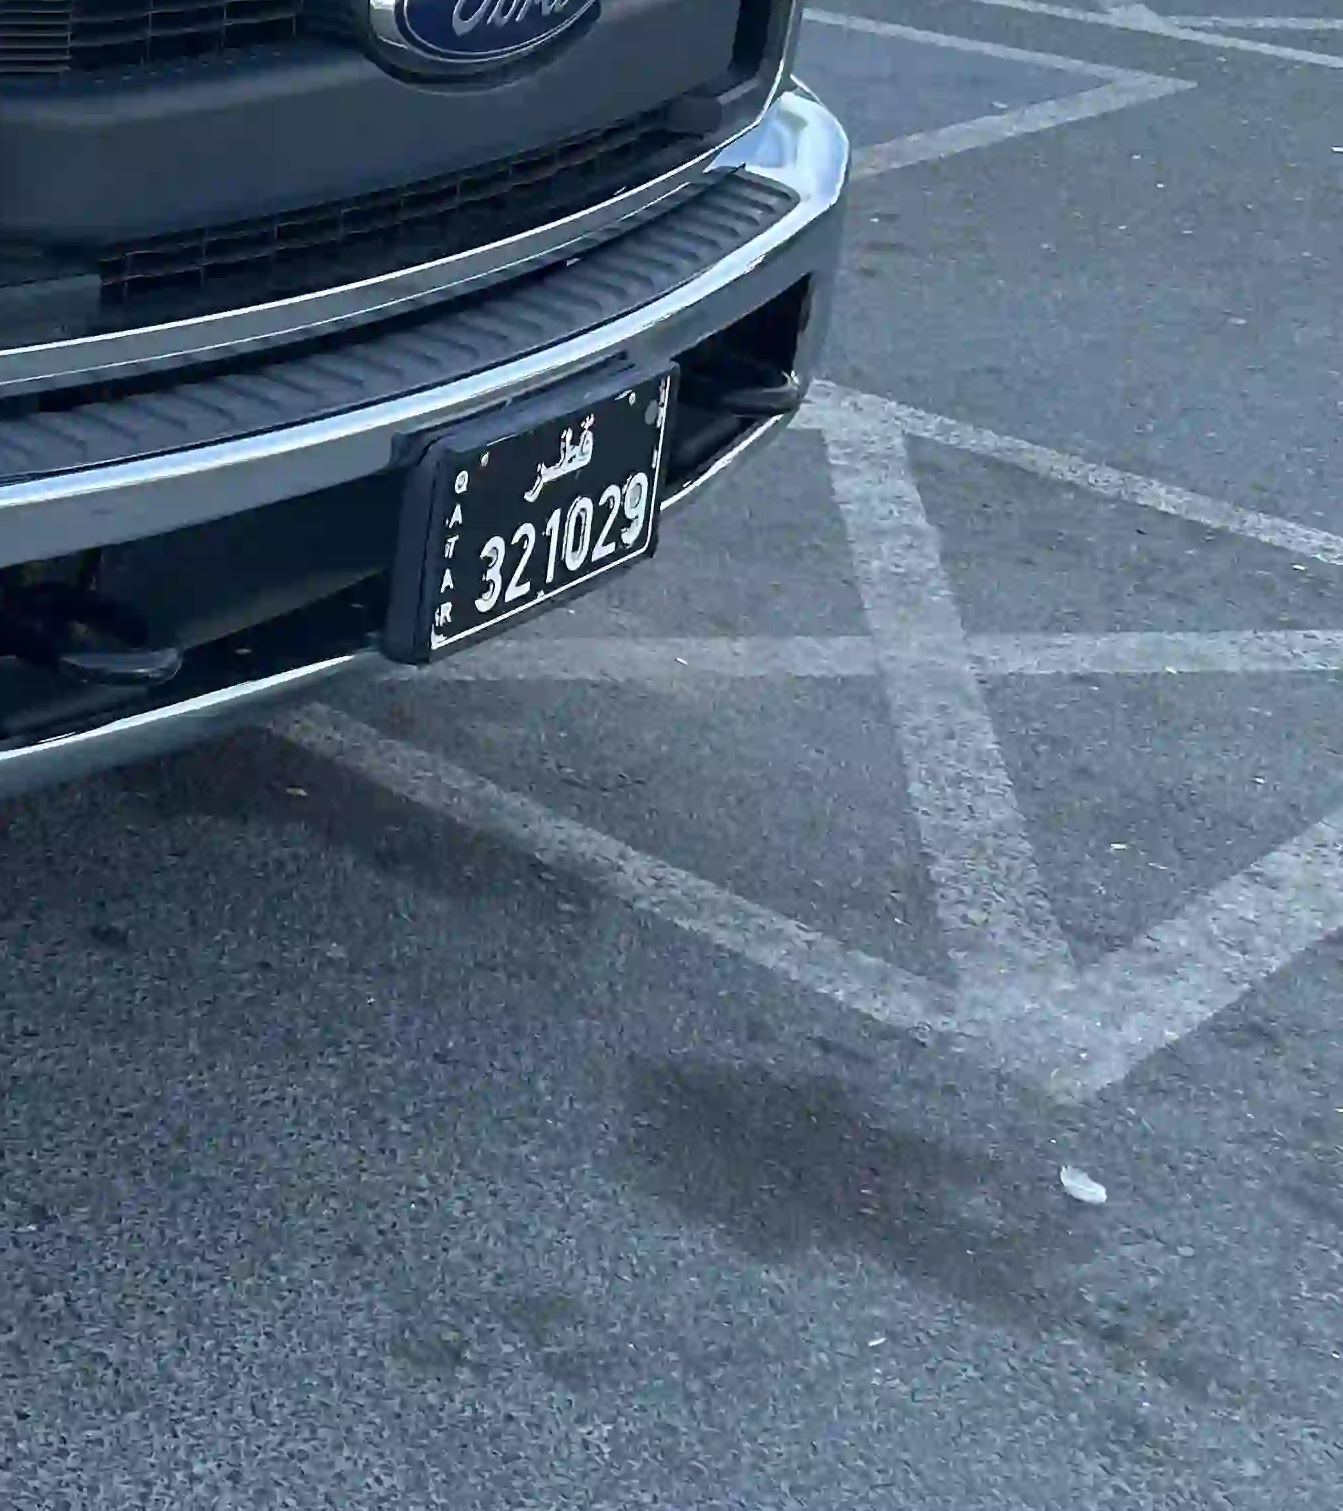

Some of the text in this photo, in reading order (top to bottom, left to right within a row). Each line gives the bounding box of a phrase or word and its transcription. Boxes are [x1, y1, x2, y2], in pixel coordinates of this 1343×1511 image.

[523, 412, 595, 503] قطر
[434, 470, 469, 627] QATAR
[474, 471, 649, 613] 321029
